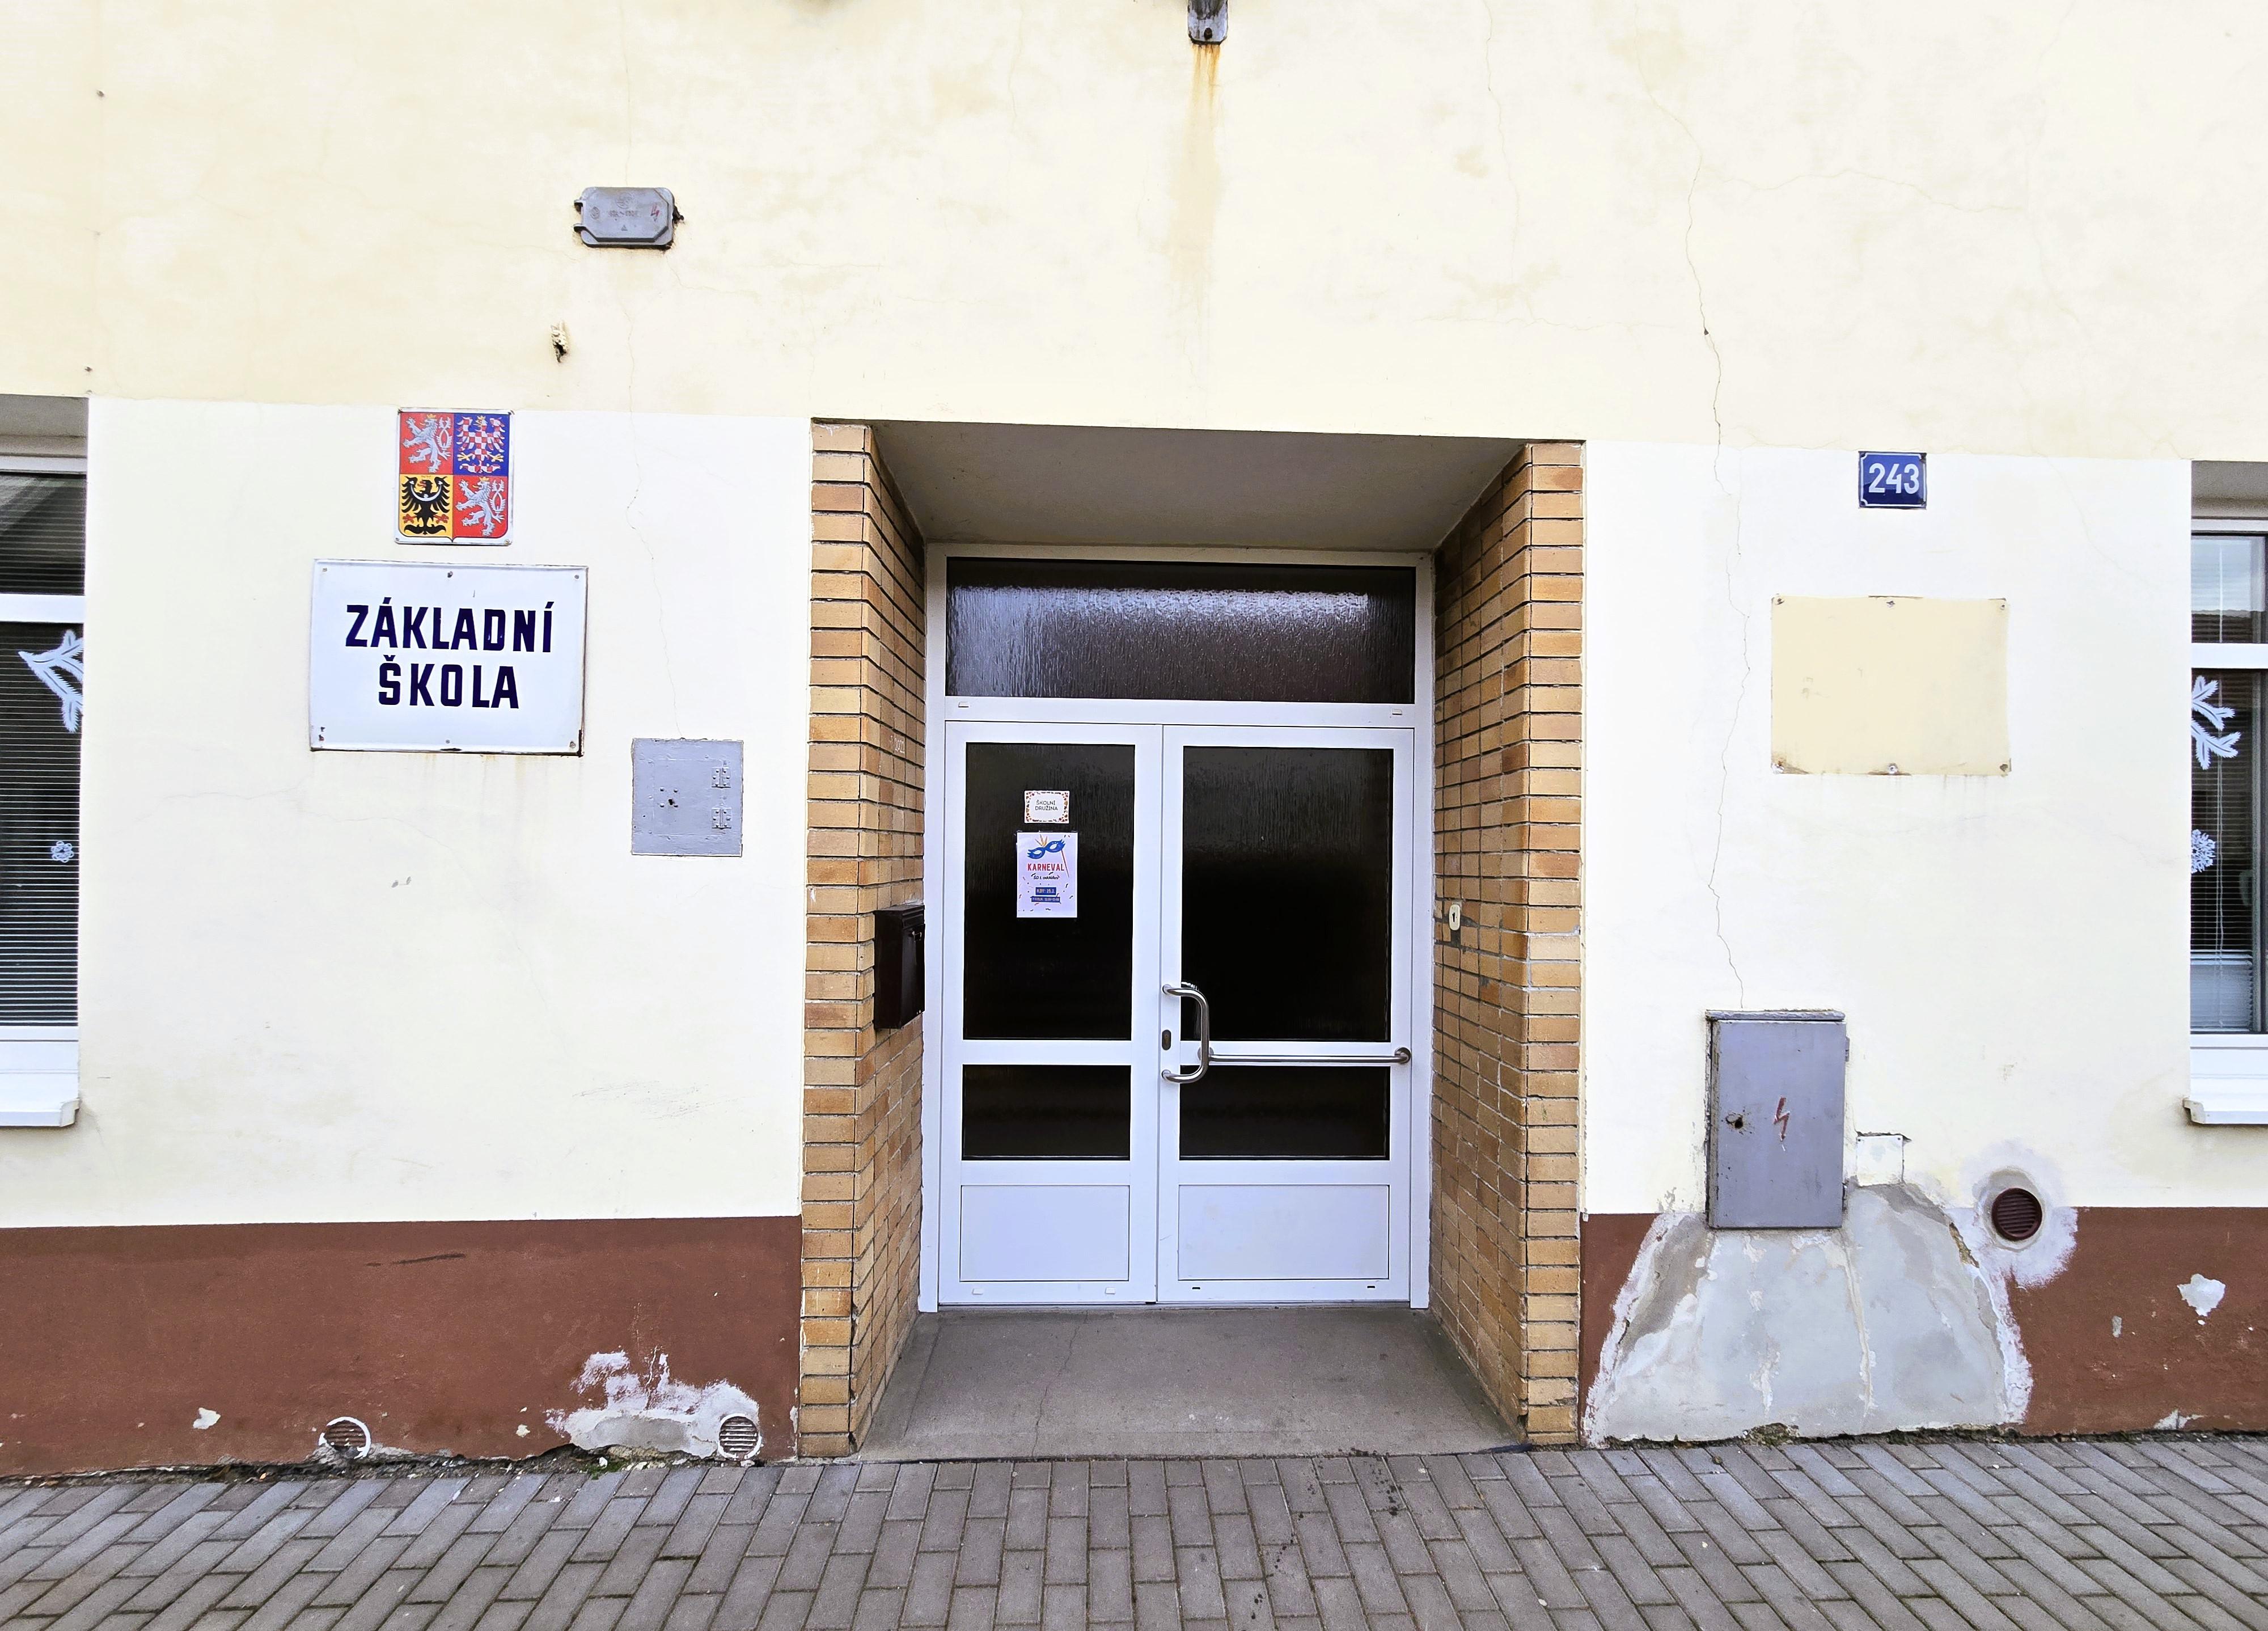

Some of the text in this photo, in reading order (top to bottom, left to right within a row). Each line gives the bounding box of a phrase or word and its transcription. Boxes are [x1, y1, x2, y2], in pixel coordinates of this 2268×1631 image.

[1869, 463, 1919, 494] 243
[345, 597, 554, 653] ZÁKLADNÍ
[379, 655, 519, 709] ŠKOLA
